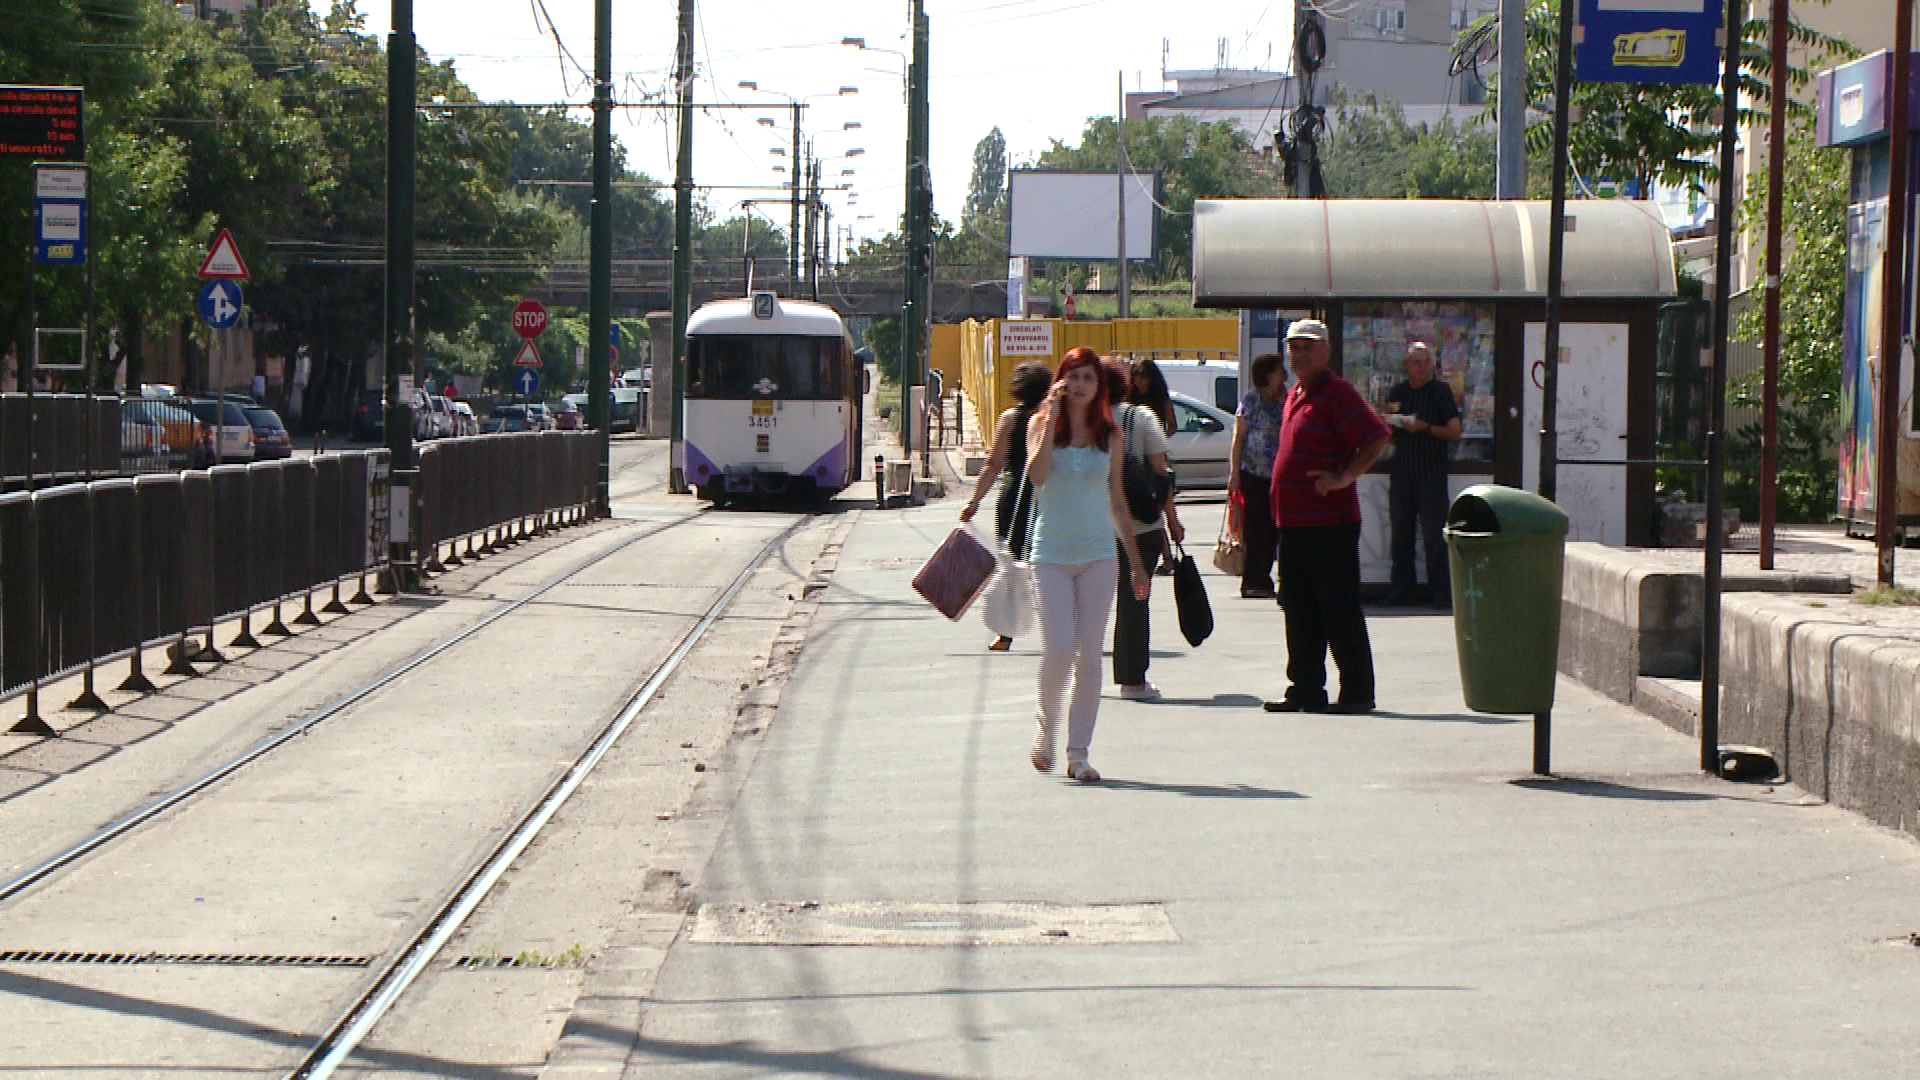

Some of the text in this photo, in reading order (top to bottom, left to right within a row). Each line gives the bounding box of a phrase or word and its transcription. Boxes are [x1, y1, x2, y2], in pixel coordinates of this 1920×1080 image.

[514, 311, 545, 327] STOP
[1009, 325, 1042, 333] CIRCULATI
[748, 416, 777, 428] 3451
